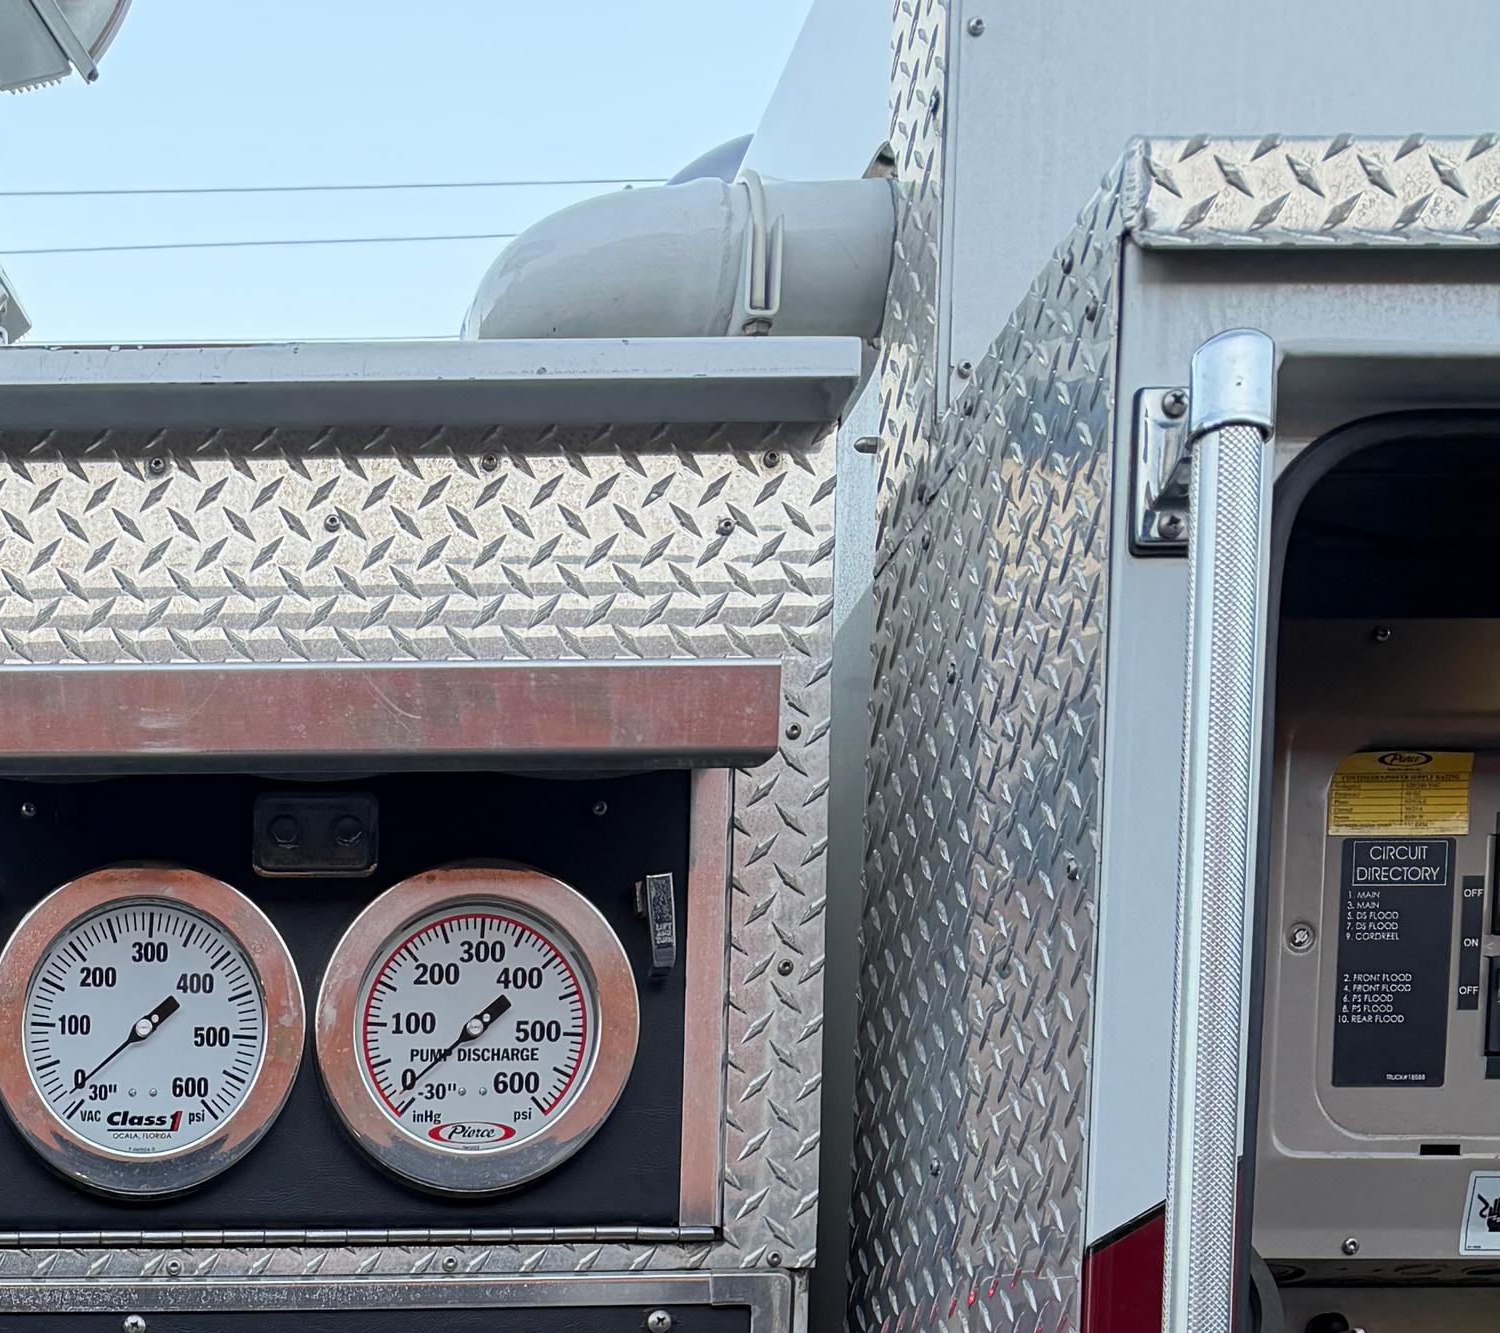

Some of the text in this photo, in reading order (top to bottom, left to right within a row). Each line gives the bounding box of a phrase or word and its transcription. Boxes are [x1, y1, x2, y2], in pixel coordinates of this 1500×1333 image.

[1370, 846, 1428, 860] CIRCUIT
[1357, 867, 1440, 881] DIRECTORY
[1464, 889, 1483, 897] OFF
[132, 942, 168, 962] 300
[459, 941, 506, 962] 300
[80, 967, 116, 987] 200
[176, 973, 214, 994] 400
[413, 963, 459, 985] 200
[496, 967, 542, 989] 400
[1459, 986, 1478, 994] OFF
[59, 1015, 90, 1035] 100
[392, 1012, 436, 1034] 100
[515, 1020, 561, 1042] 500
[194, 1027, 230, 1047] 500
[410, 1048, 539, 1061] PUMP DISCHARGE
[74, 1069, 86, 1089] 0
[172, 1077, 208, 1097] 600
[402, 1068, 416, 1090] 0
[493, 1072, 539, 1094] 600
[80, 1110, 101, 1121] VAC
[189, 1110, 205, 1125] psi
[412, 1111, 441, 1124] inHg
[514, 1109, 532, 1122] psi
[448, 1124, 495, 1139] Pierce
